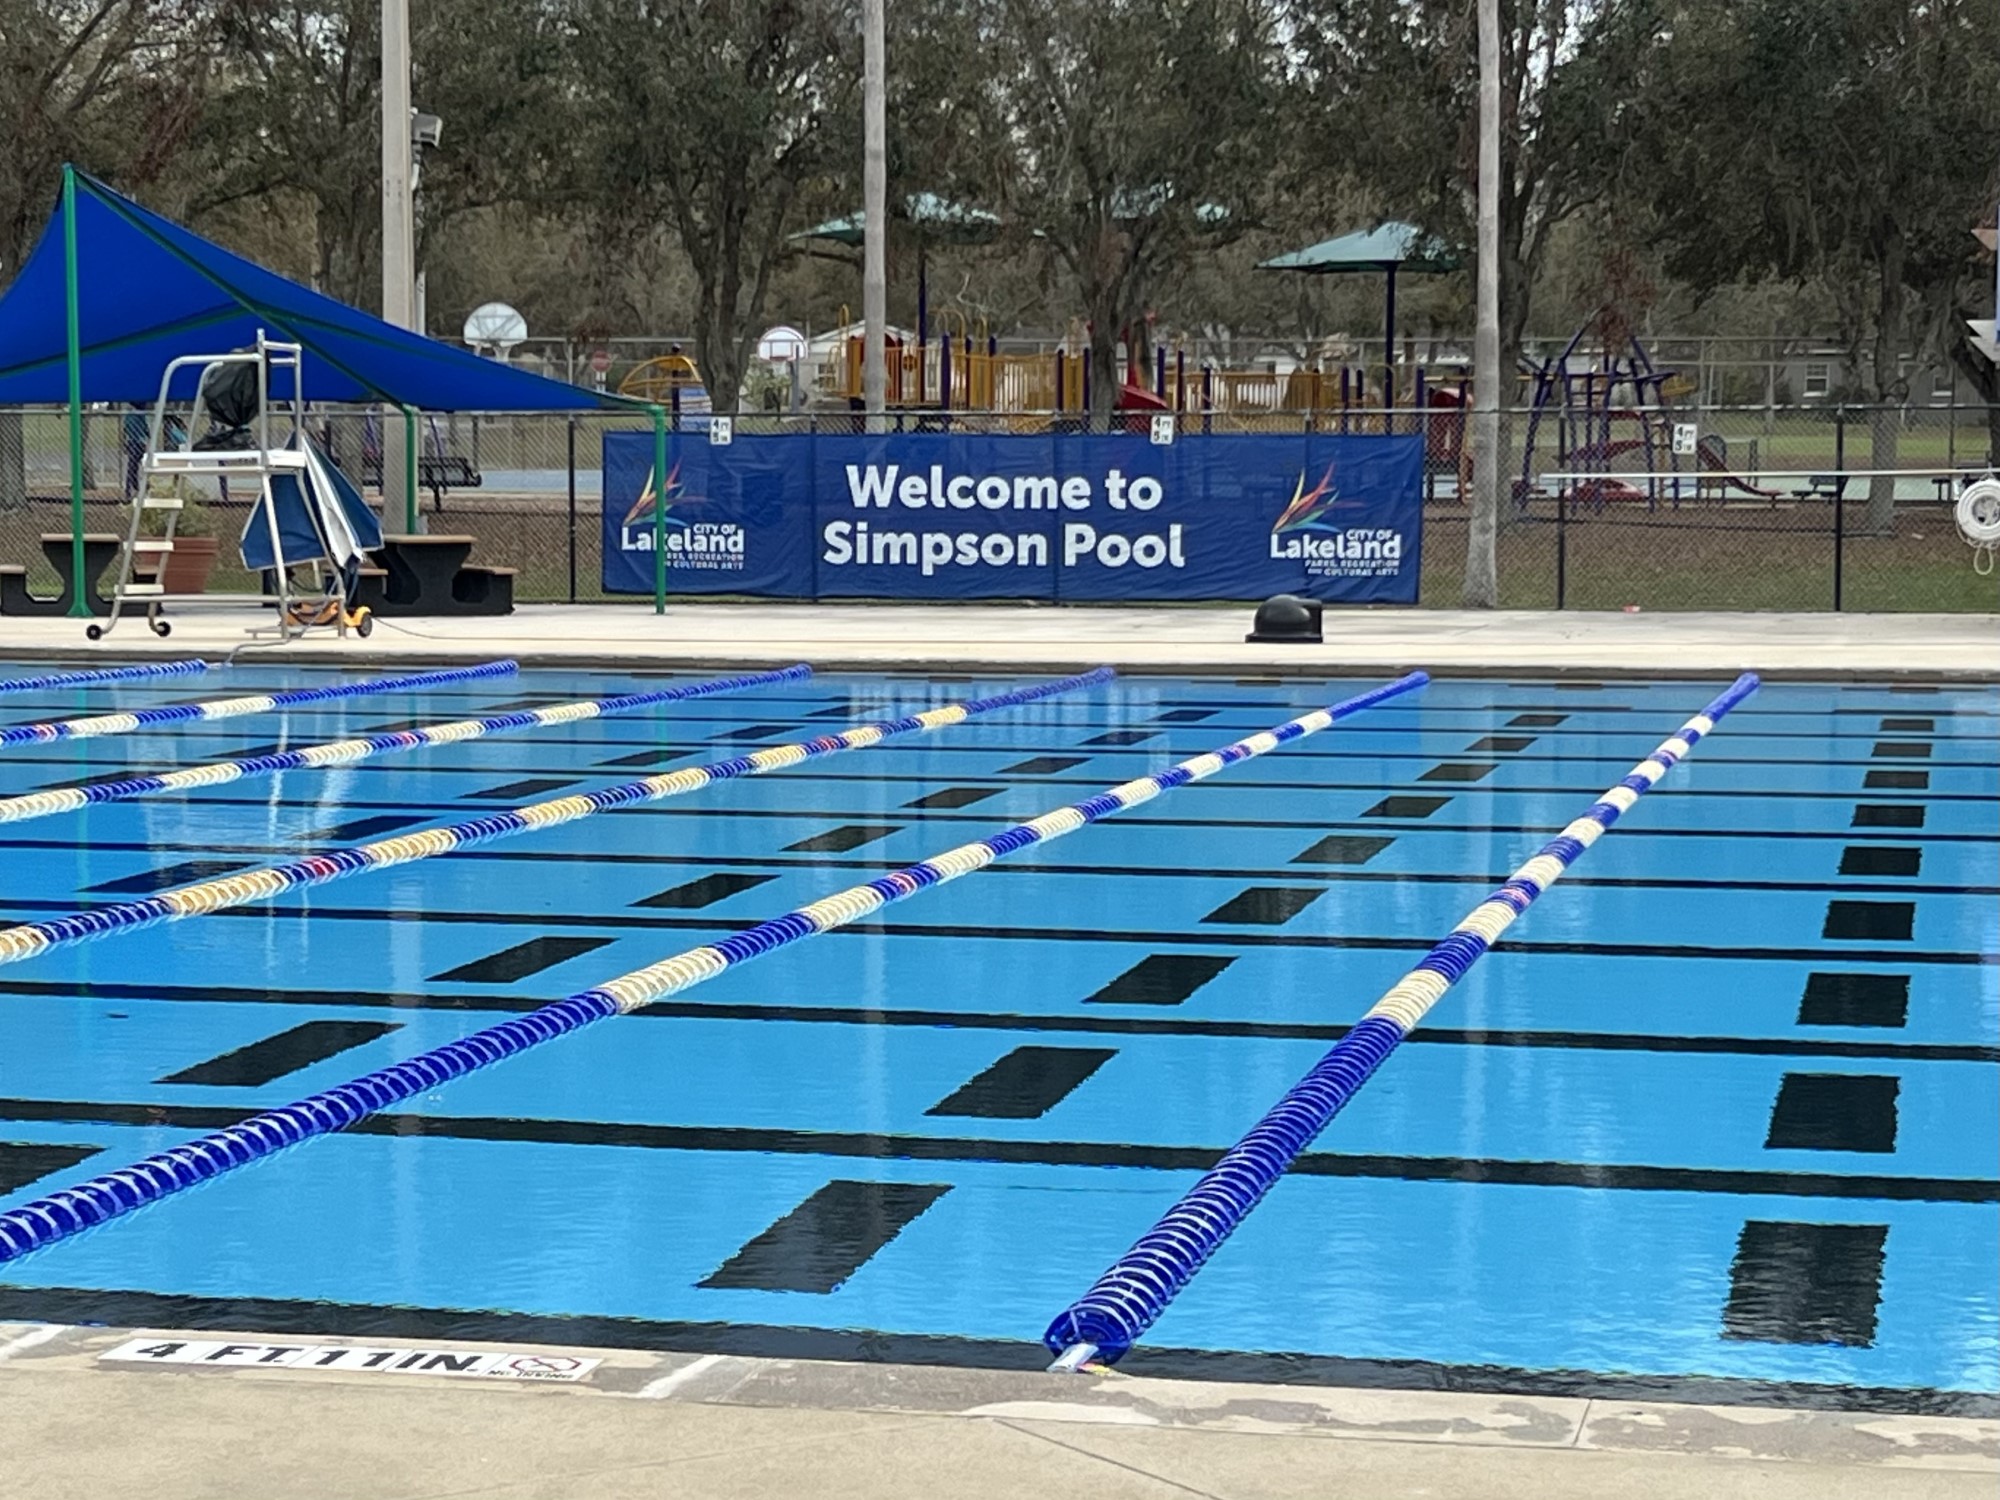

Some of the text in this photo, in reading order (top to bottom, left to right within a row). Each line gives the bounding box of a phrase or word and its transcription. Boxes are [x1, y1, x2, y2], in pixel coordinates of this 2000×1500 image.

[712, 418, 720, 430] 4
[1153, 416, 1161, 428] 4
[1152, 431, 1161, 442] 5
[1675, 426, 1683, 437] 4
[845, 464, 1164, 511] Welcome to
[693, 523, 737, 535] CITY OF
[1346, 528, 1394, 541] CITY OF
[823, 520, 1186, 577] Simpson Pool
[1270, 532, 1402, 559] Lakeland
[136, 1343, 188, 1358] 4
